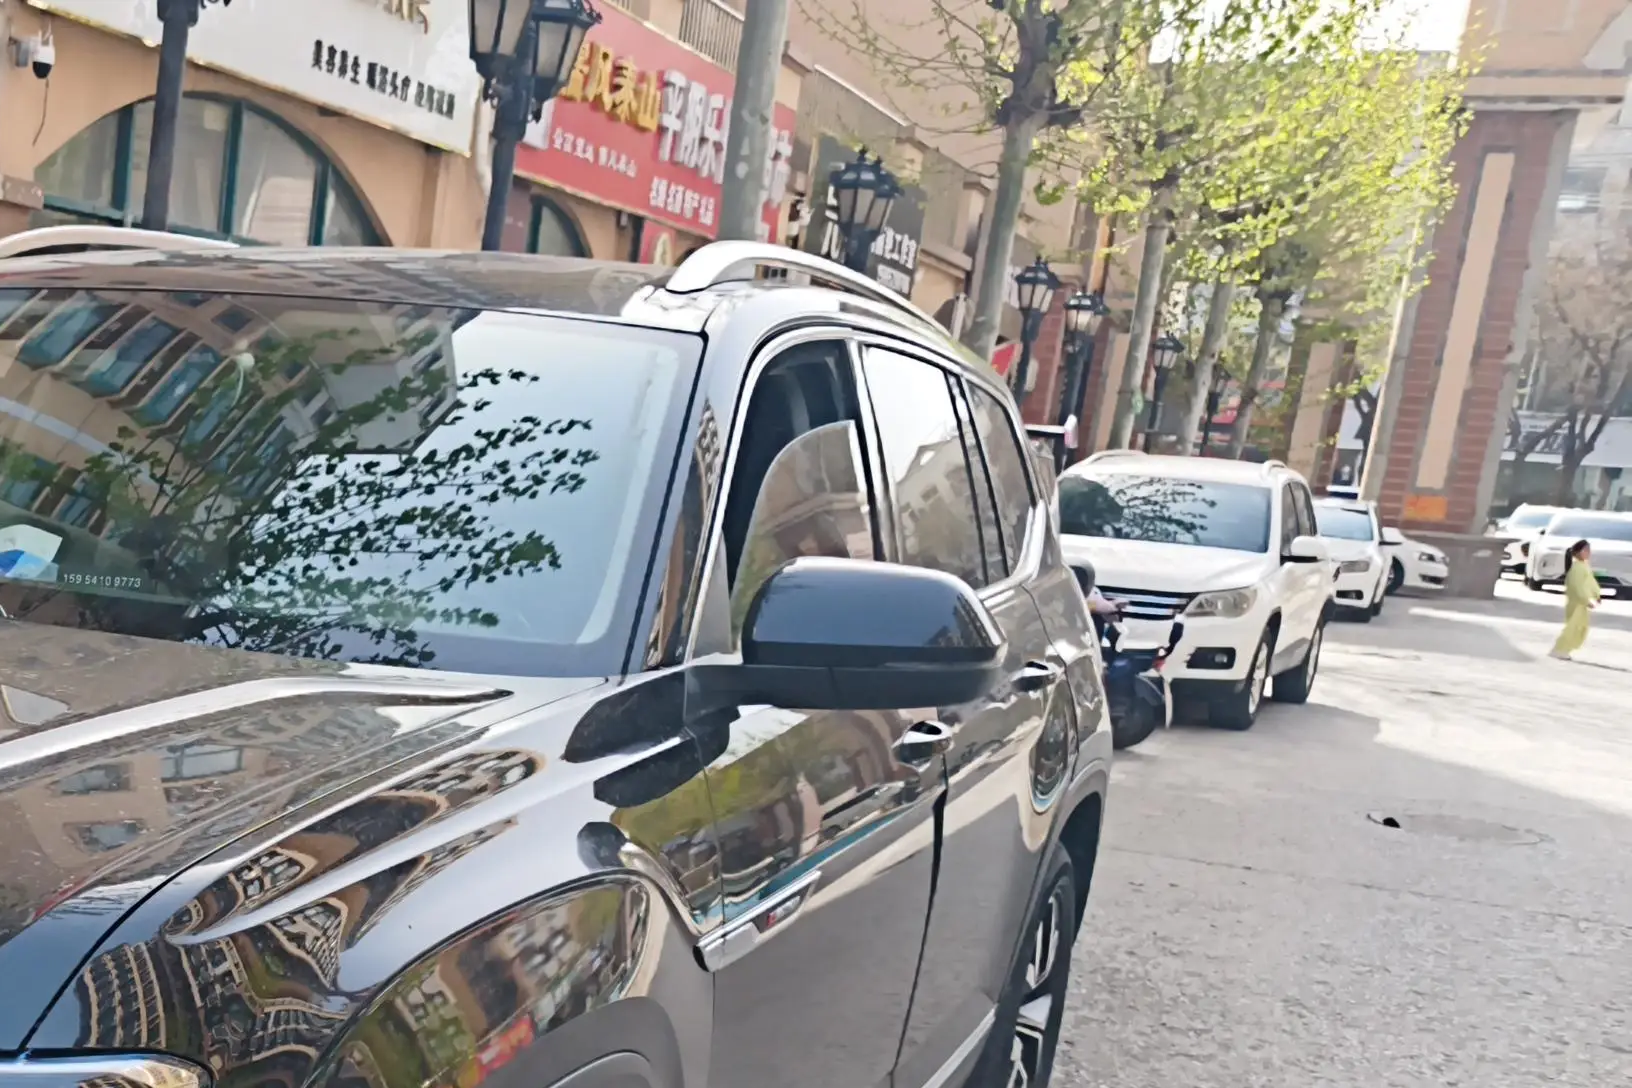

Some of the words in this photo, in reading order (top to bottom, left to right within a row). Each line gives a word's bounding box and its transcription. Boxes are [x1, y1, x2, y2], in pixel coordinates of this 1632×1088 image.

[64, 573, 82, 584] 159
[85, 574, 111, 586] 5410
[114, 576, 141, 588] 9773
